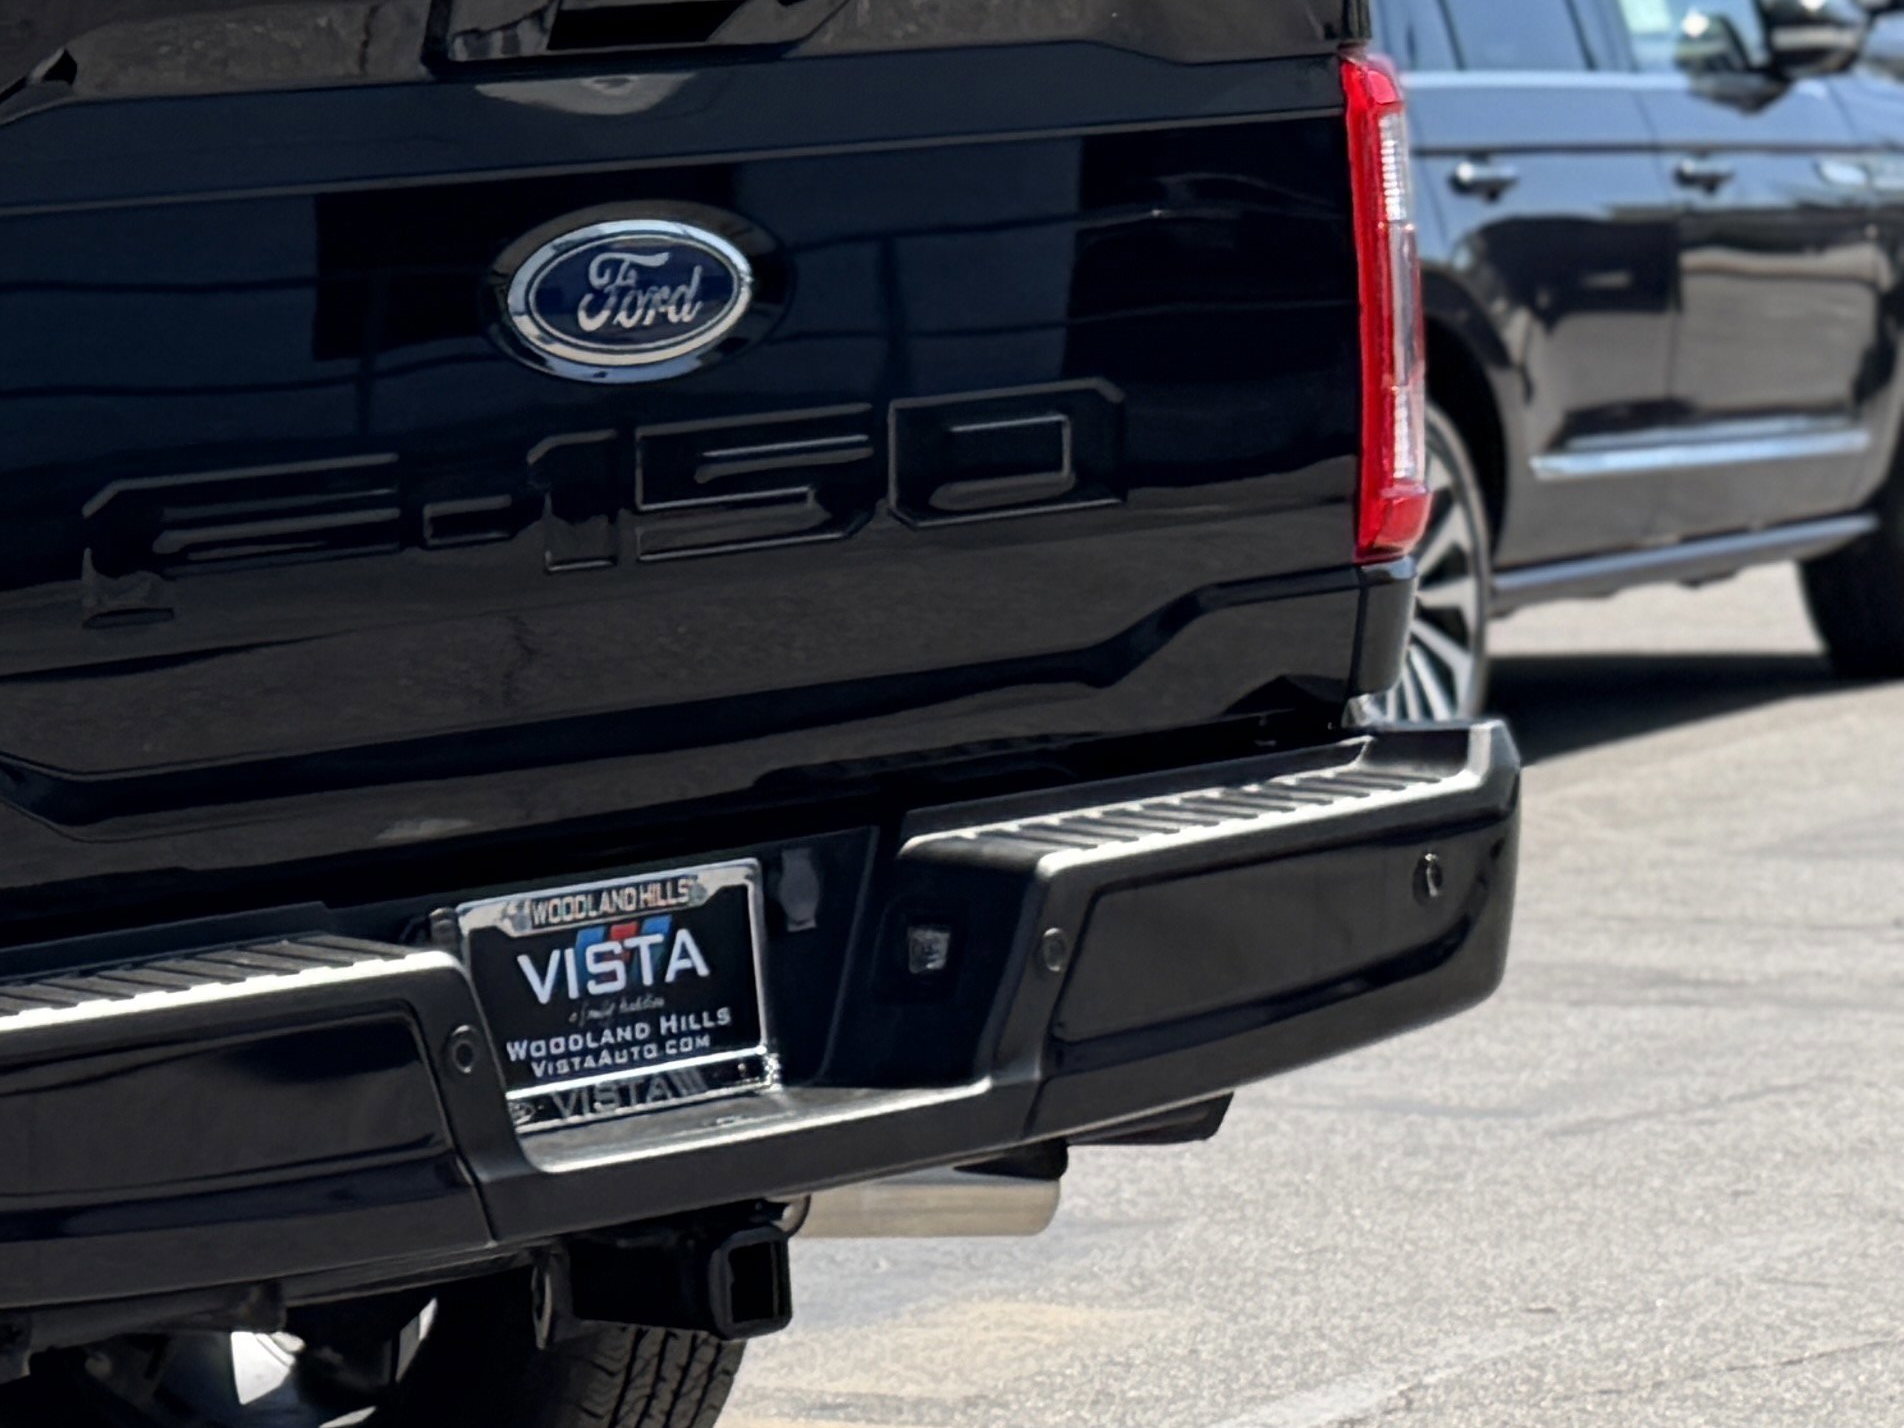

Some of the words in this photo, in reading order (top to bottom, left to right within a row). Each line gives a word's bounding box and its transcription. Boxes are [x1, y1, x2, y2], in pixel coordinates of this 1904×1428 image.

[577, 251, 704, 332] Ford
[82, 377, 1124, 629] F-150
[531, 886, 637, 926] WOODLAND
[638, 877, 690, 910] HILLS
[517, 928, 711, 1005] VISTA
[506, 1022, 651, 1062] WOODLAND
[659, 1006, 732, 1036] HILLS
[551, 1070, 674, 1119] VISTA
